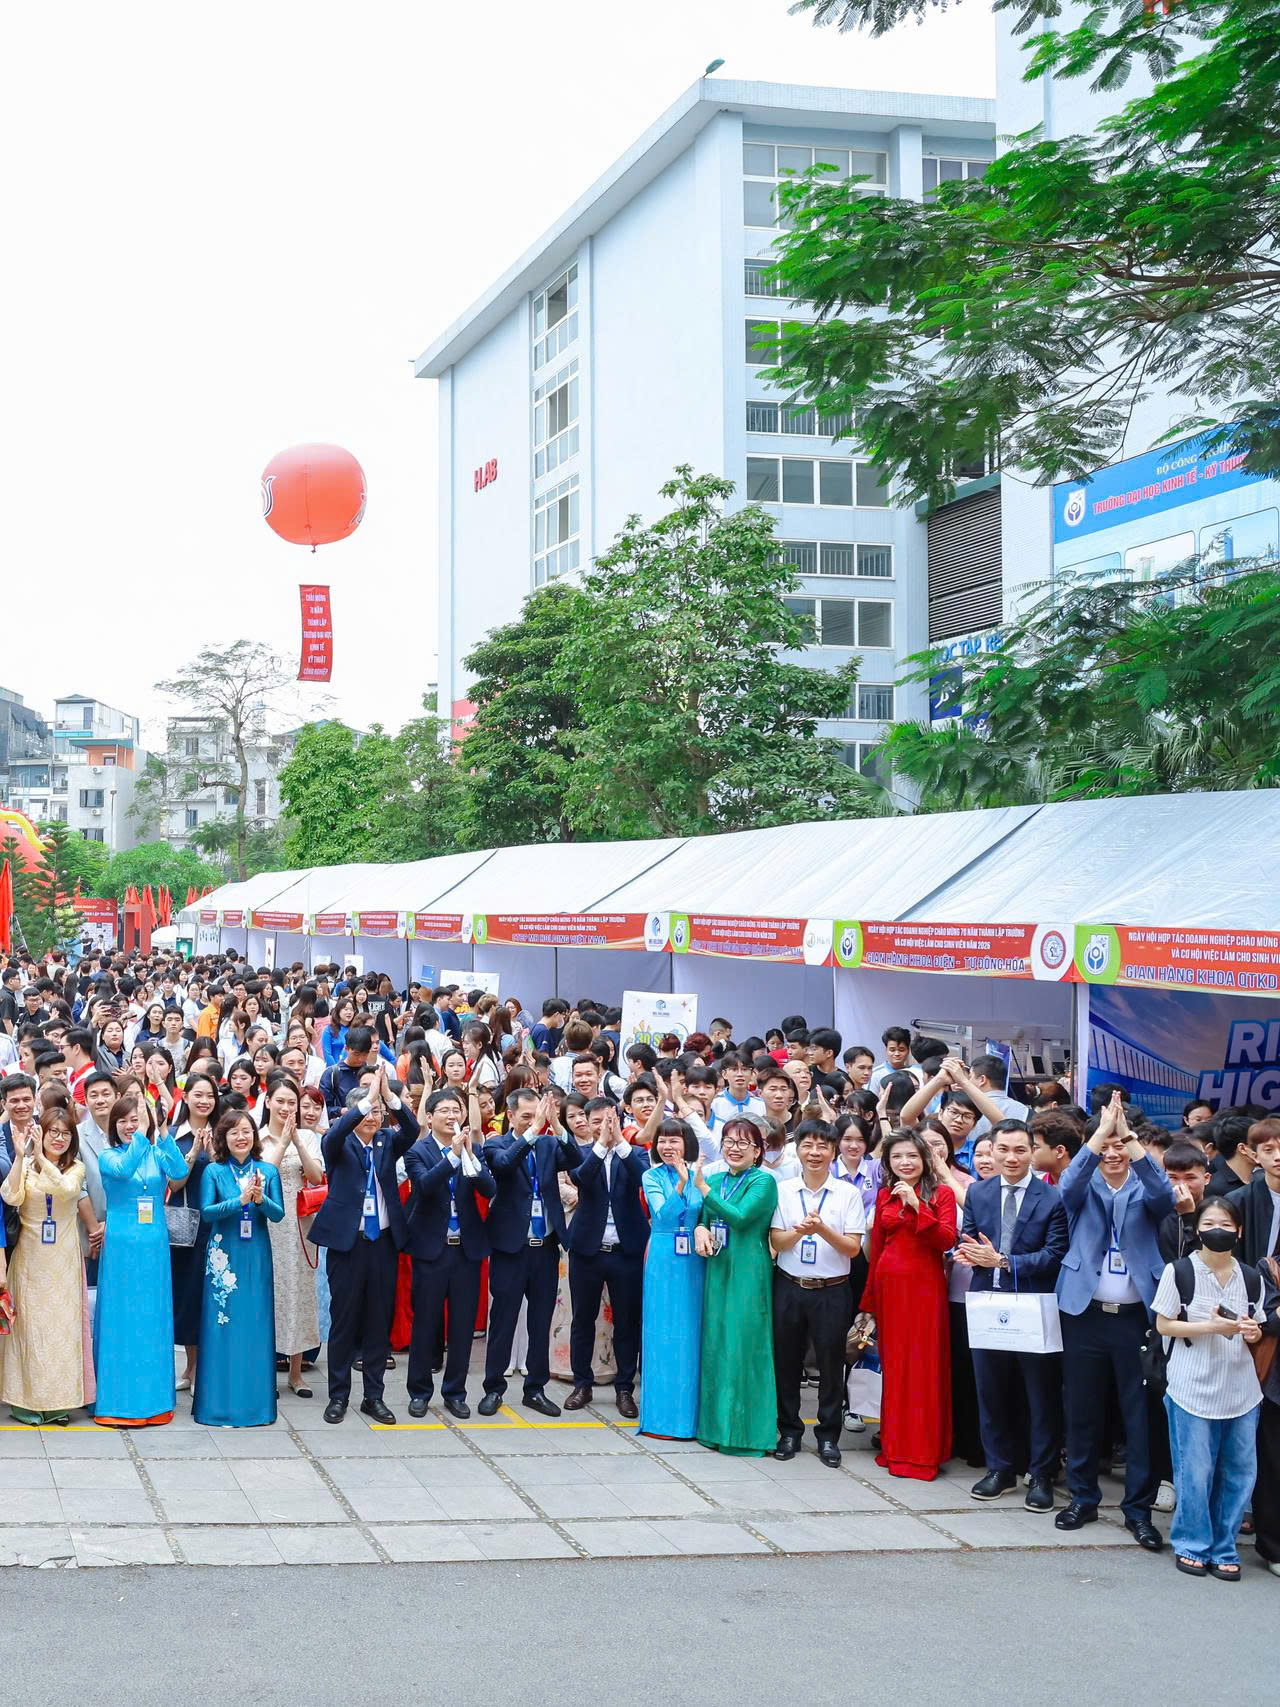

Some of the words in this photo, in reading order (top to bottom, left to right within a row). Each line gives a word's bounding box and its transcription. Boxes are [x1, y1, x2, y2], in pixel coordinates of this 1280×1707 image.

[1093, 495, 1124, 515] TRƯỜNG
[1126, 490, 1141, 504] ĐẠI
[1142, 483, 1160, 500] HỌC
[1162, 474, 1184, 492] KINH
[1186, 466, 1198, 485] TẾ
[1205, 461, 1218, 480] KỸ
[1128, 931, 1144, 942] NGÀY
[1146, 932, 1157, 944] HỘI
[1158, 933, 1170, 944] HỢP
[1172, 933, 1185, 943] TÁC
[1185, 934, 1209, 945] DOANH
[1209, 934, 1235, 947] NGHIỆP
[1236, 934, 1256, 946] CHÀO
[1257, 936, 1278, 948] MỪNG
[866, 951, 885, 964] GIAN
[886, 951, 908, 966] HÀNG
[1171, 947, 1180, 958] VÀ
[1181, 949, 1190, 959] CƠ
[1191, 948, 1202, 961] HỘI
[1203, 949, 1219, 962] VIỆC
[1220, 949, 1235, 962] LÀM
[1236, 952, 1250, 962] CHO
[1252, 953, 1269, 963] SINH
[1125, 964, 1156, 980] GIAN
[1158, 964, 1194, 983] HÀNG
[1196, 968, 1235, 986] KHOA
[1238, 972, 1278, 989] QTKD
[1228, 1021, 1280, 1064] RI
